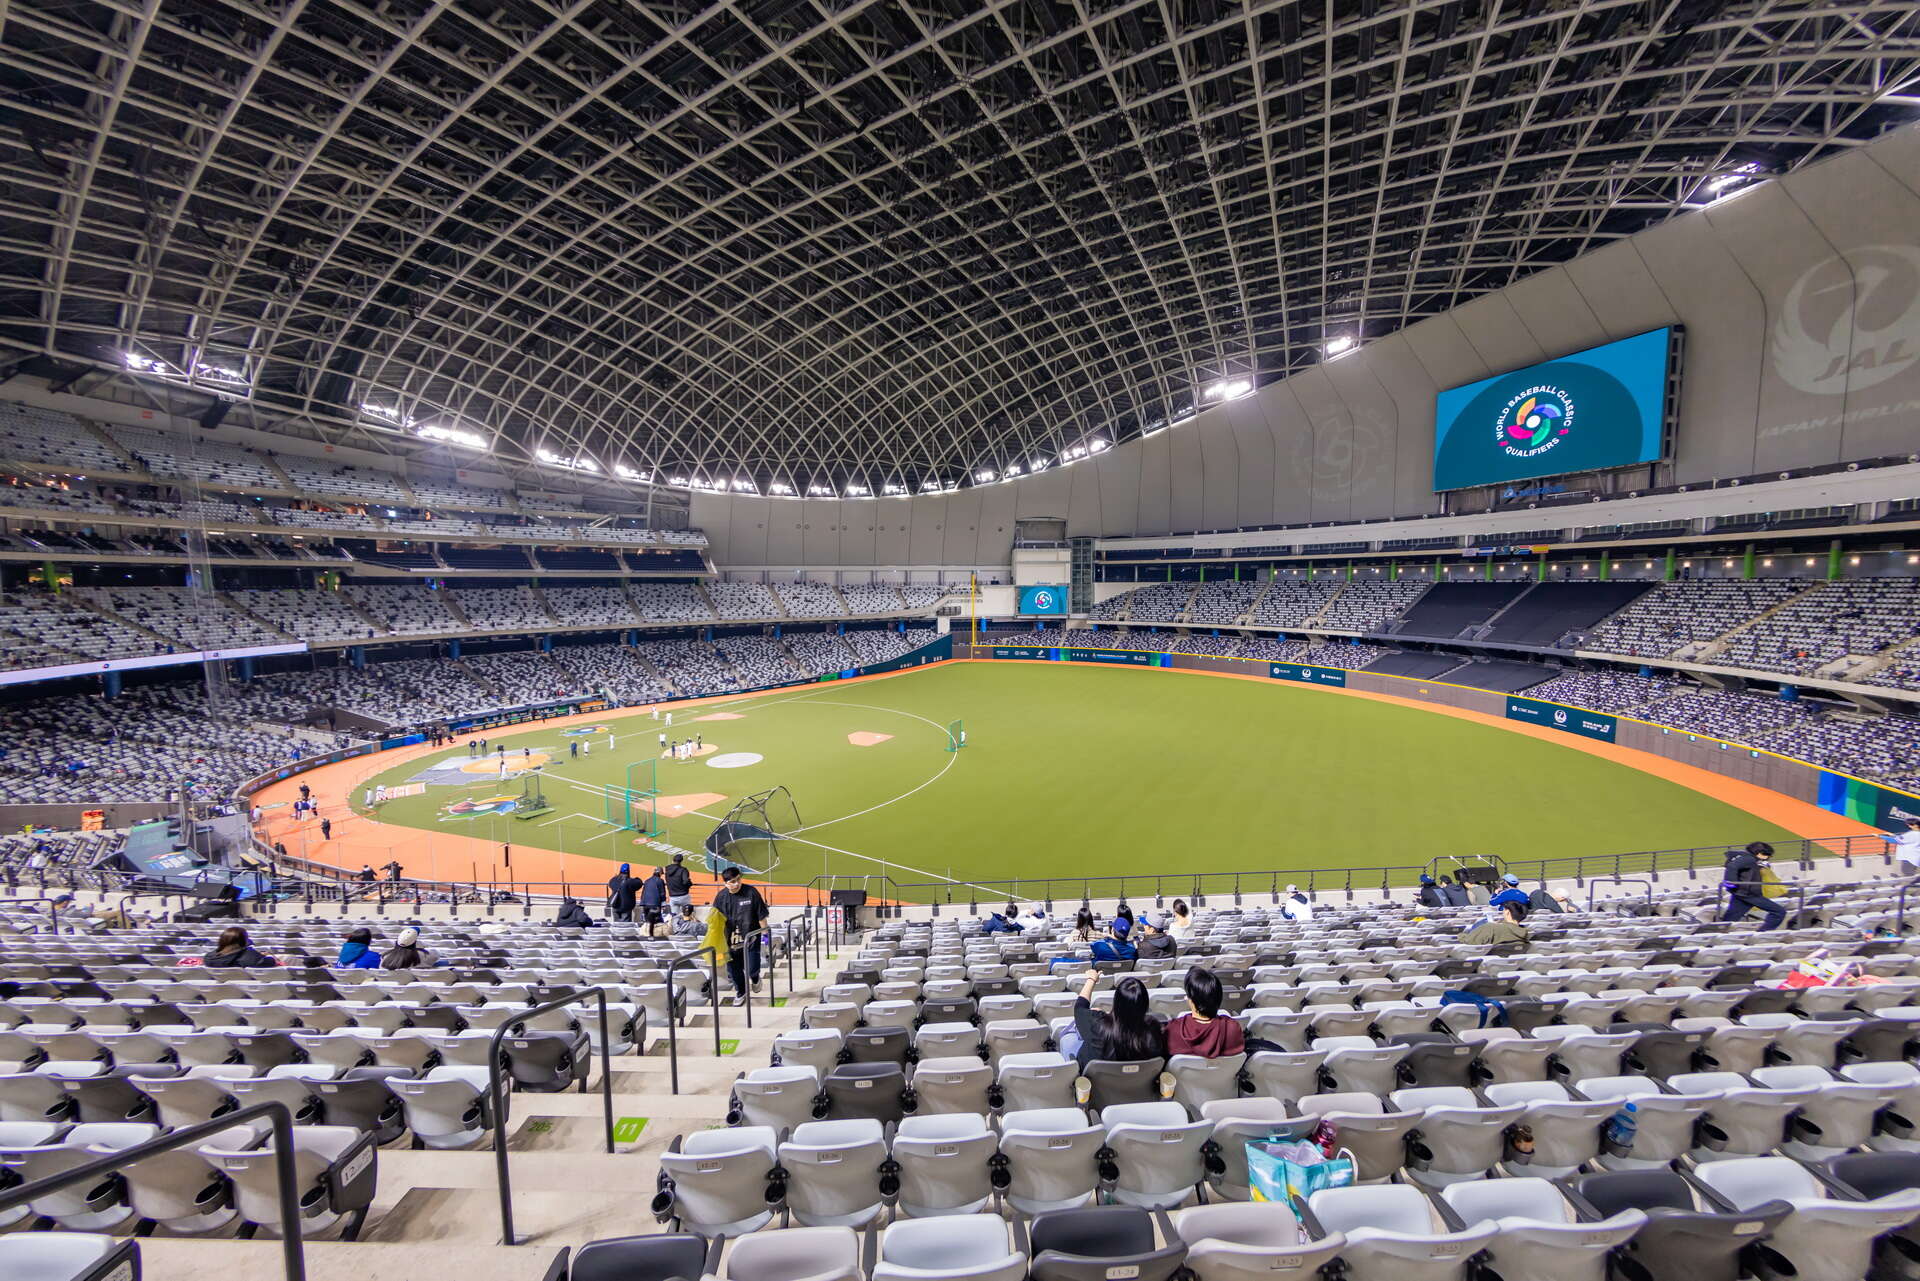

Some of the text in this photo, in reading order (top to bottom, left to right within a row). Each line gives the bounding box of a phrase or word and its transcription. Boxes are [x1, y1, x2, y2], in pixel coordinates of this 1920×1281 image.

[1813, 338, 1914, 382] JAL
[1495, 385, 1576, 440] WORLD BASEBALL CLASSIC
[1505, 437, 1560, 457] QUALIFIERS
[528, 1120, 553, 1133] 205
[619, 1123, 638, 1136] 11
